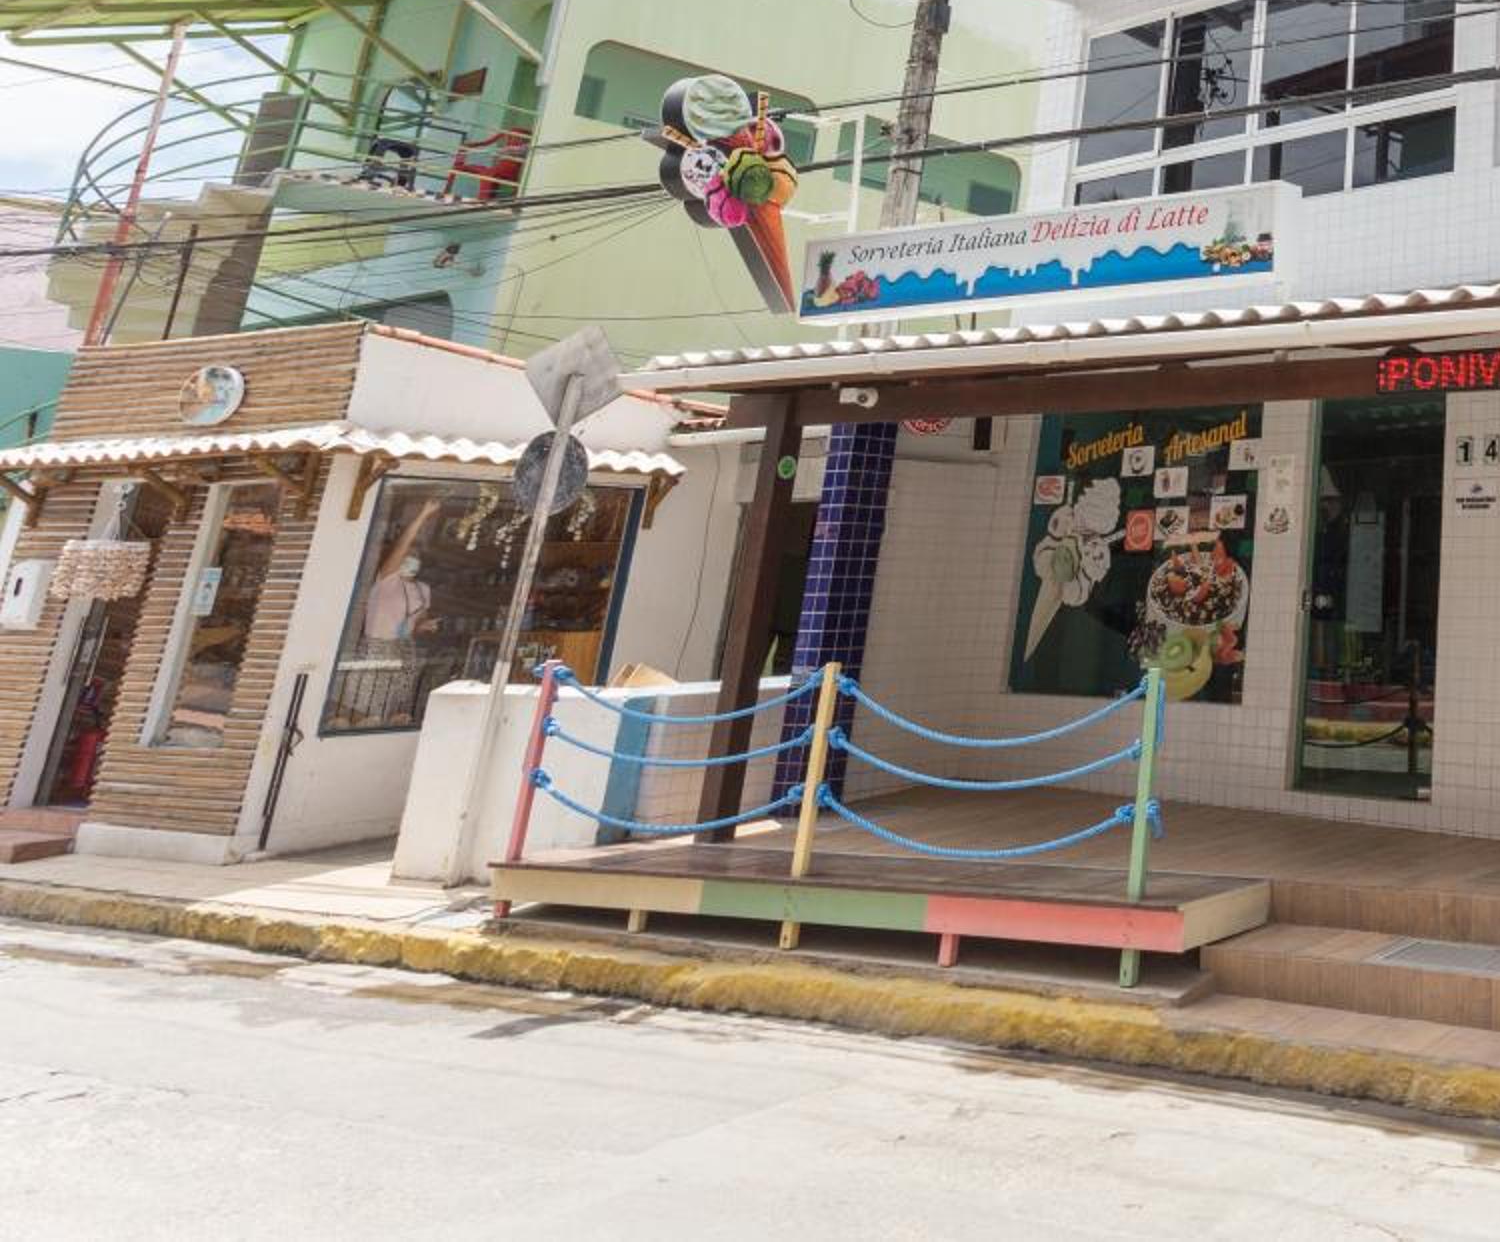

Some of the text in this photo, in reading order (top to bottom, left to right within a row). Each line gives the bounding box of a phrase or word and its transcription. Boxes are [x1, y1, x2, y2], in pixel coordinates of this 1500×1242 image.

[1031, 204, 1210, 244] Delizia di Latte
[848, 228, 1027, 264] Sorveteria Italiana
[1067, 410, 1248, 467] Sorveteria Artesanal
